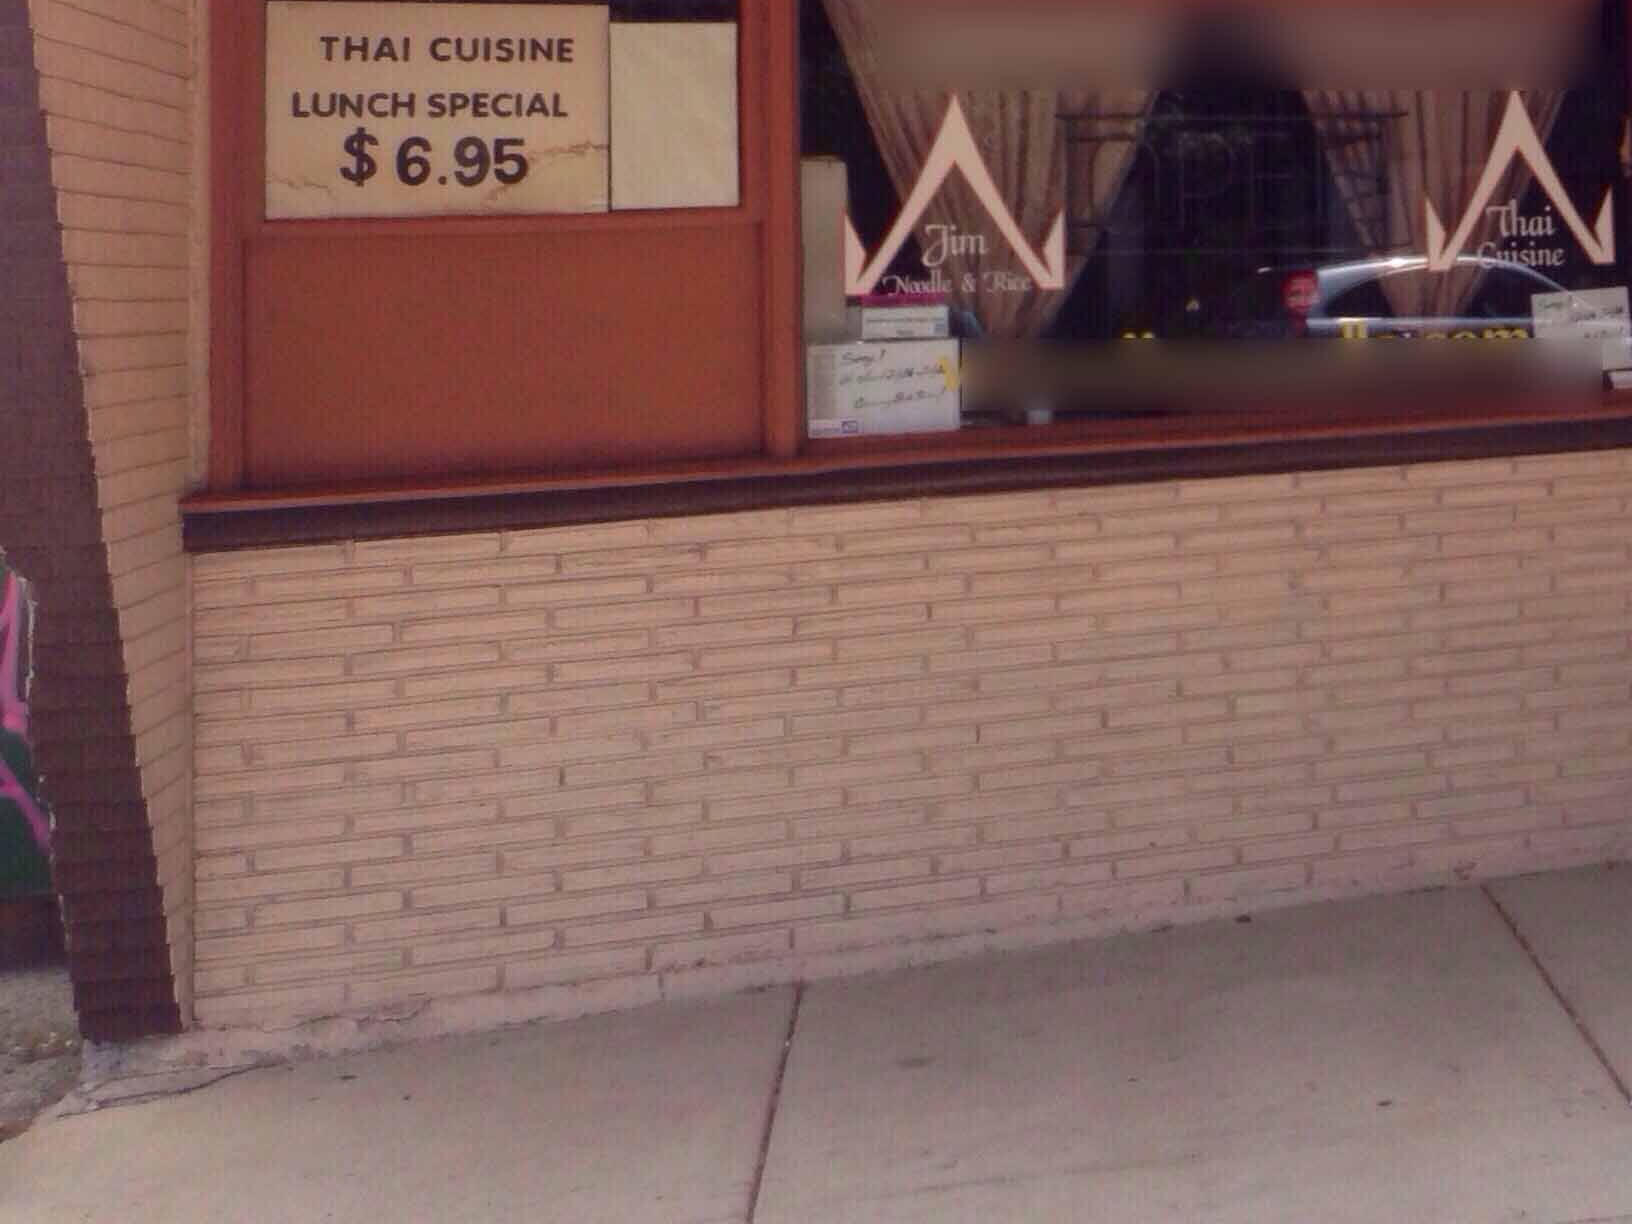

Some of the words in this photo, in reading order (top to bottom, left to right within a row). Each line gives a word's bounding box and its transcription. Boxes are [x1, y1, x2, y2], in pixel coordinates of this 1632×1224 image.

[320, 36, 411, 63] THAI
[428, 36, 575, 64] CUISINE
[291, 91, 416, 119] LUNCH
[426, 91, 569, 119] SPECIAL
[1484, 197, 1558, 238] Thai
[921, 223, 991, 268] Jim
[1476, 240, 1566, 270] Cuisine
[882, 270, 953, 296] Noodle
[983, 270, 1034, 293] Rice
